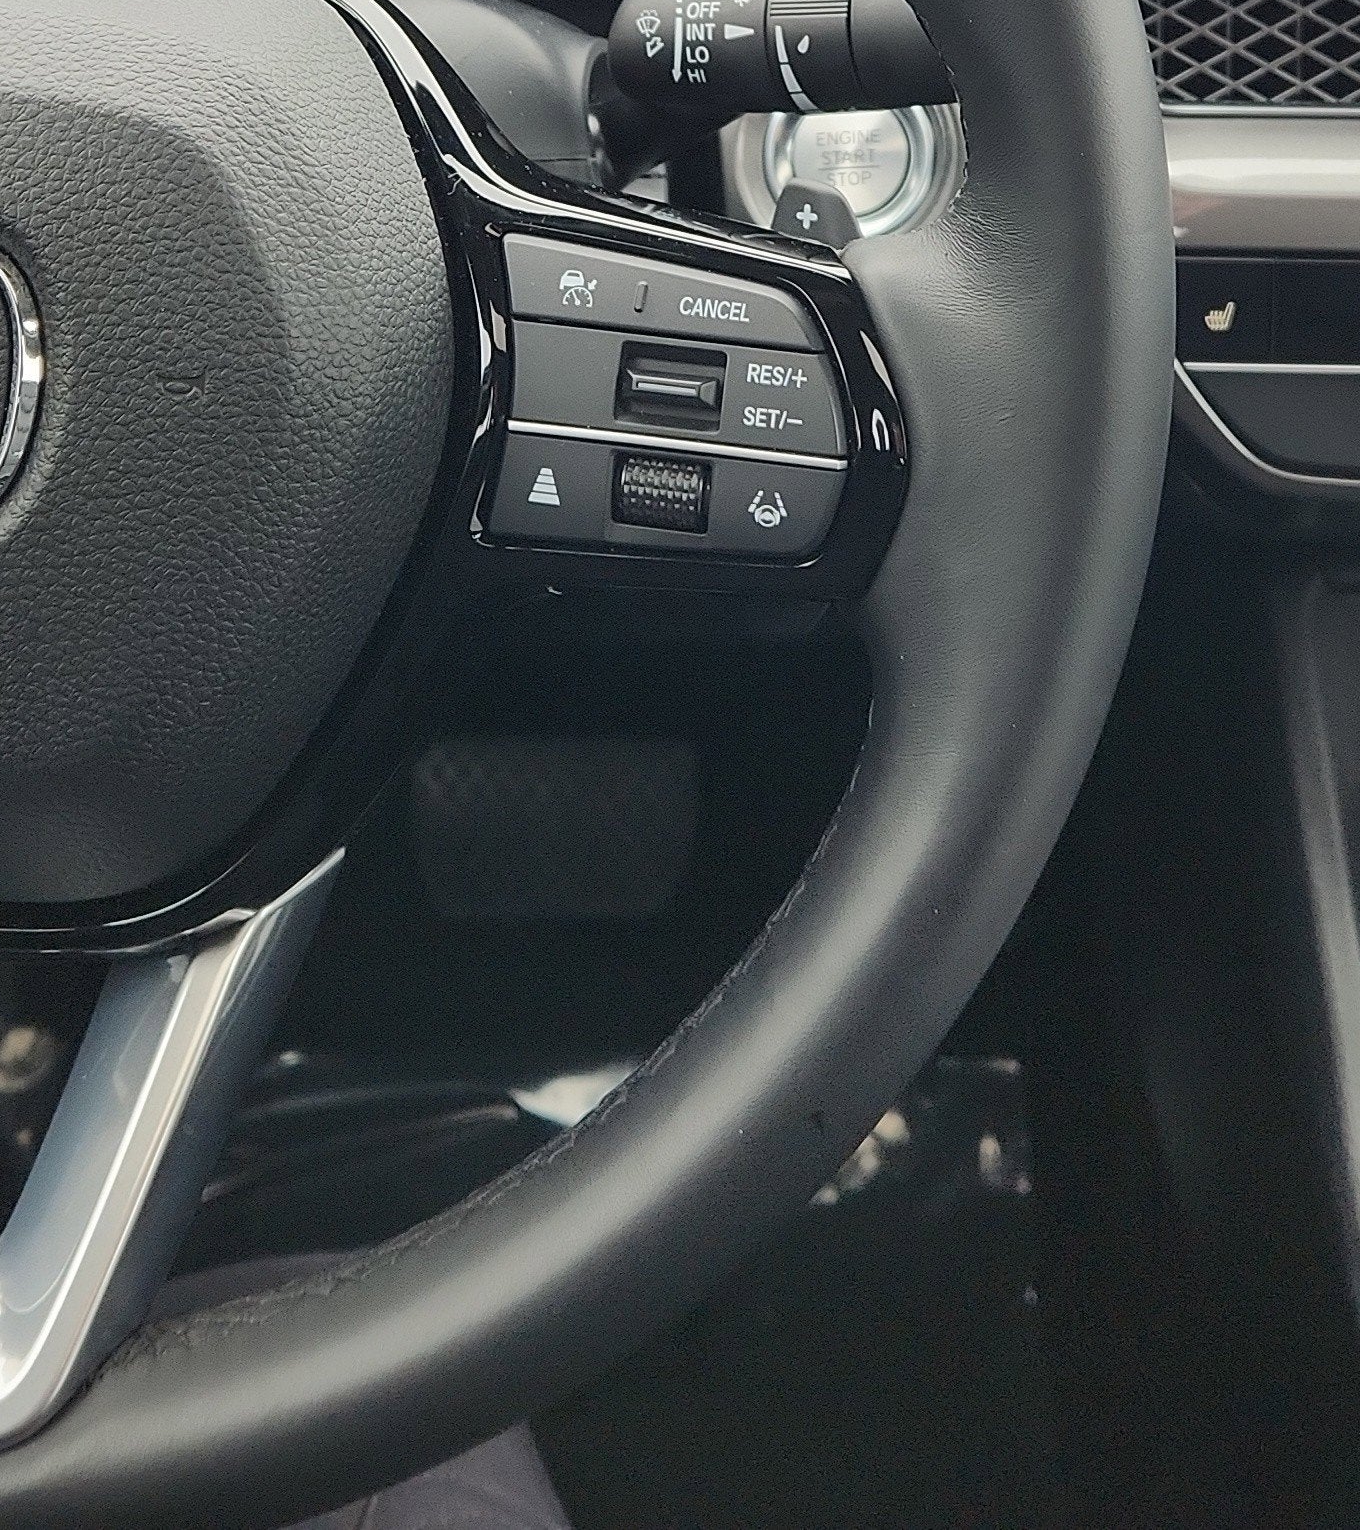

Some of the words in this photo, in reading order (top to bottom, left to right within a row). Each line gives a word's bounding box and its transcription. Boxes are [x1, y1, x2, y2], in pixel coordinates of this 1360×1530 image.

[686, 1, 721, 19] OFF
[686, 23, 716, 41] INT
[686, 46, 710, 63] LO
[687, 68, 707, 83] HI
[815, 128, 882, 147] ENGINE
[821, 148, 875, 165] START
[827, 170, 872, 186] STOP
[678, 296, 750, 322] CANCEL
[746, 362, 808, 389] RES/+
